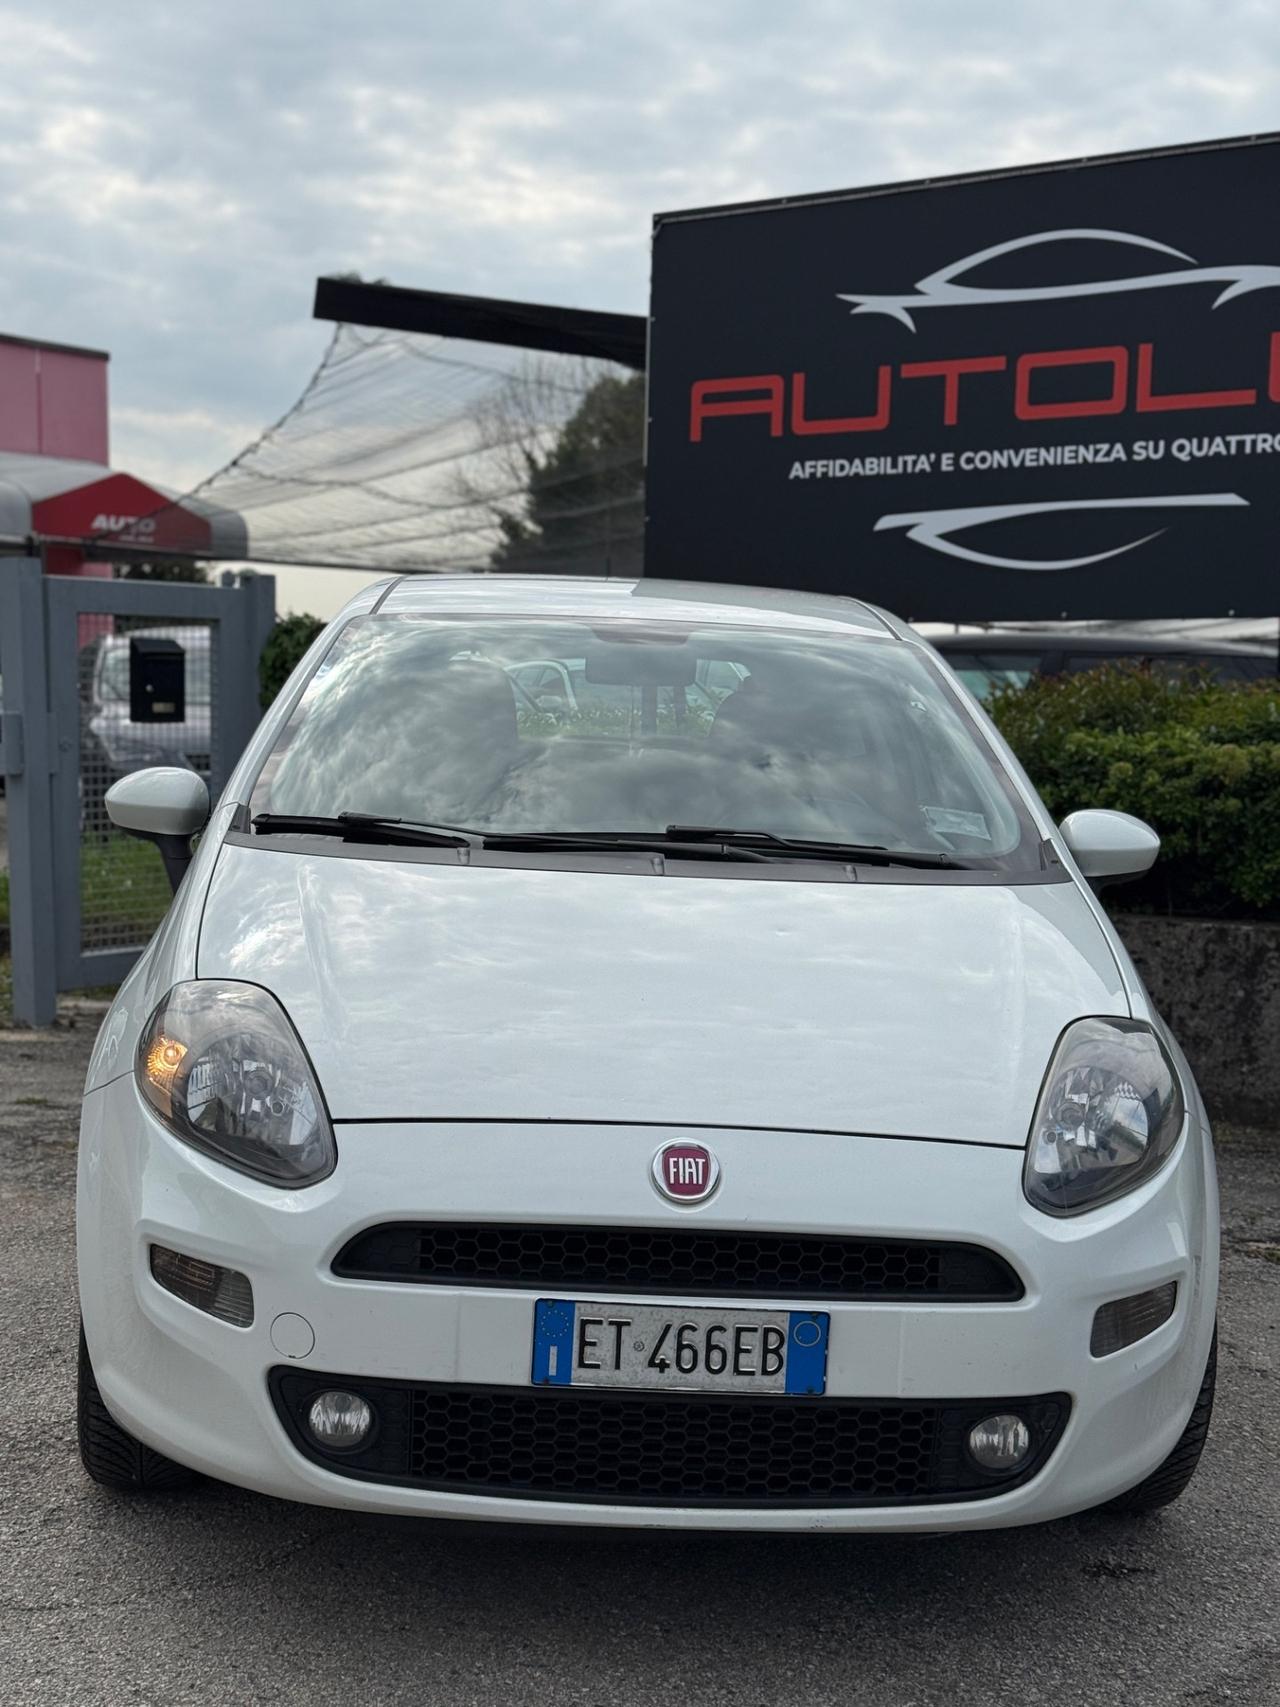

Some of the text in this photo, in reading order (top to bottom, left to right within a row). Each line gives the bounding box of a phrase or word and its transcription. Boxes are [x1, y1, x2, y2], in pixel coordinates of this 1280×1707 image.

[690, 331, 1280, 443] AUTOL
[941, 453, 955, 472] E
[959, 442, 1127, 472] CONVENIENZA
[1132, 439, 1164, 462] SU
[90, 513, 156, 534] AUTO
[668, 1157, 705, 1185] FIAT
[577, 1318, 632, 1371] ET
[647, 1322, 787, 1377] 466EB
